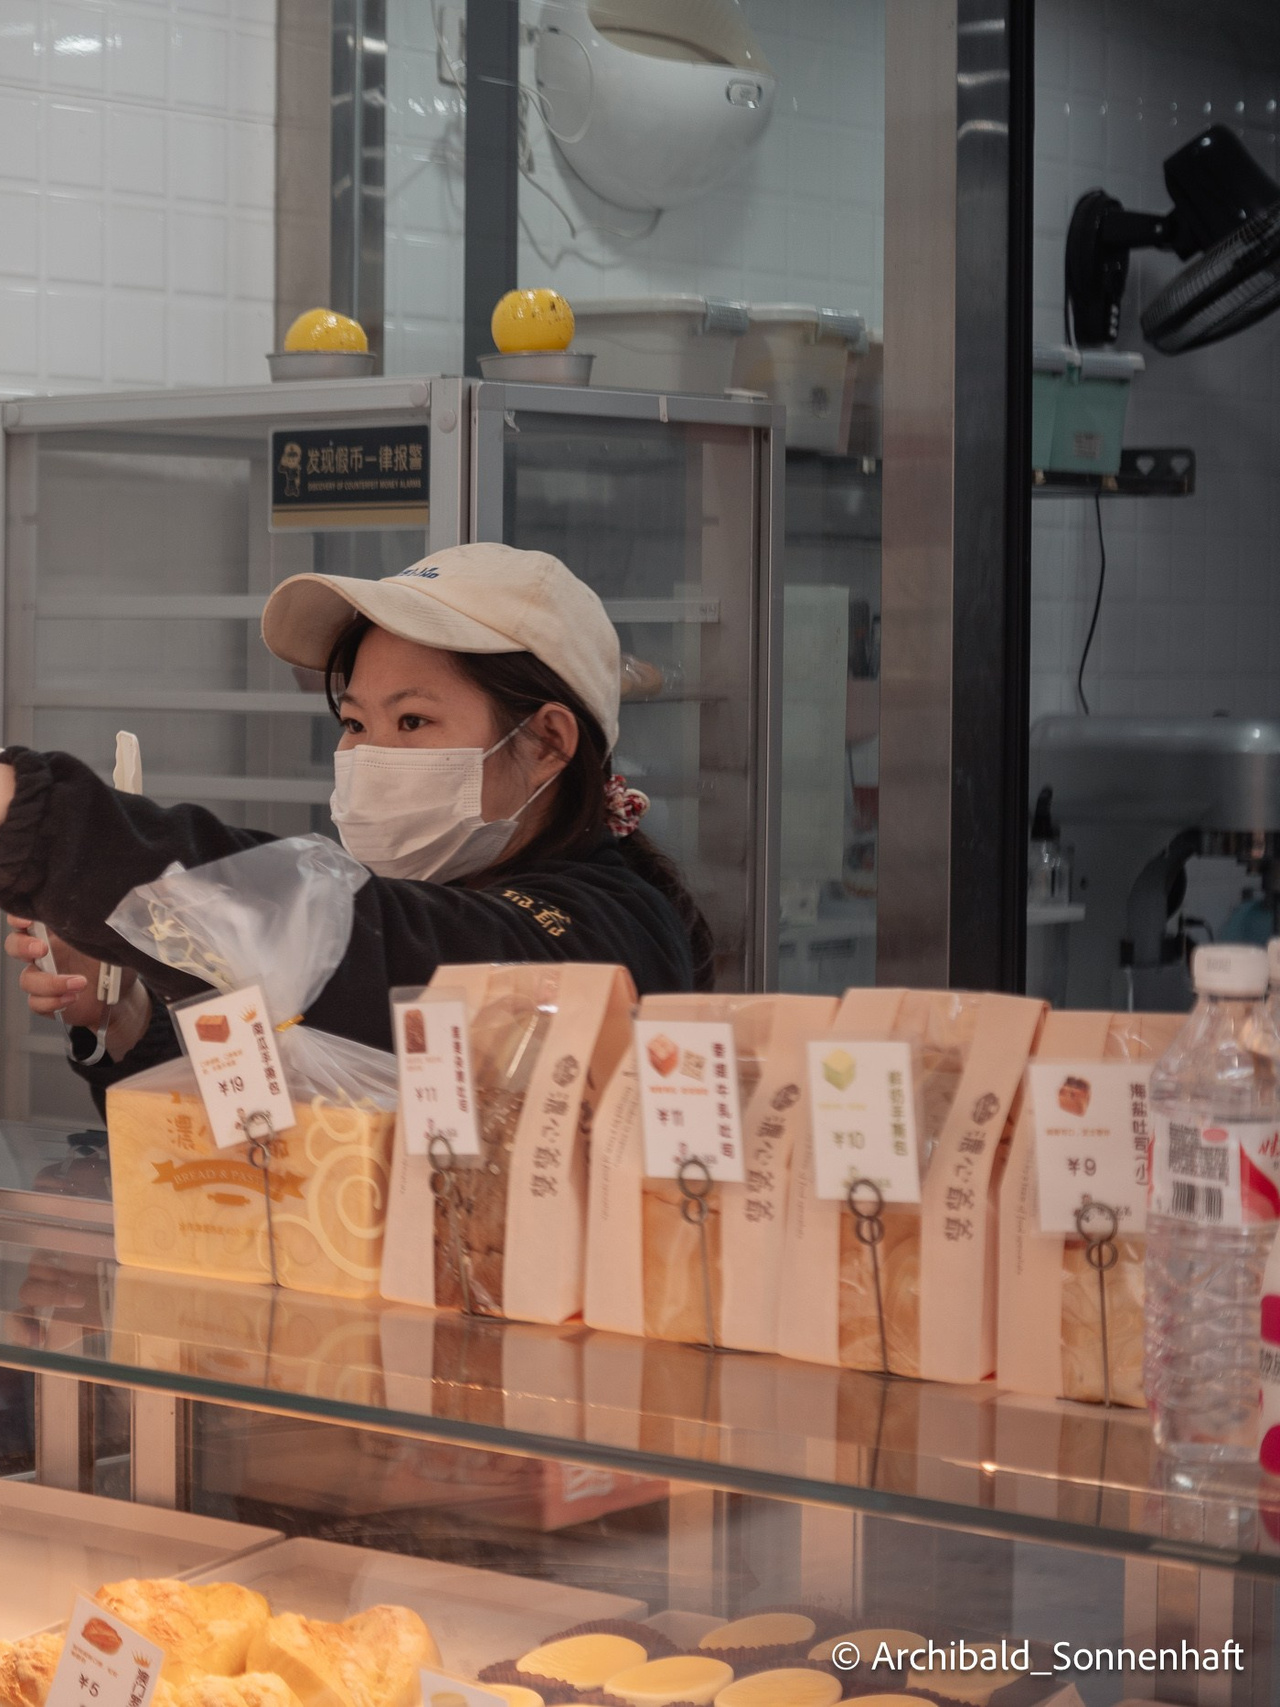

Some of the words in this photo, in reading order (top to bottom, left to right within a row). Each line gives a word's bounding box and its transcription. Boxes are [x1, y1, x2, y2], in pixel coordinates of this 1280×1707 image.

[306, 443, 423, 475] 发现假币一律报警
[217, 1076, 245, 1097] ¥19
[832, 1130, 865, 1150] ¥10
[173, 1169, 216, 1185] BREAD
[1067, 1157, 1097, 1177] ¥9
[78, 1673, 100, 1698] ¥5
